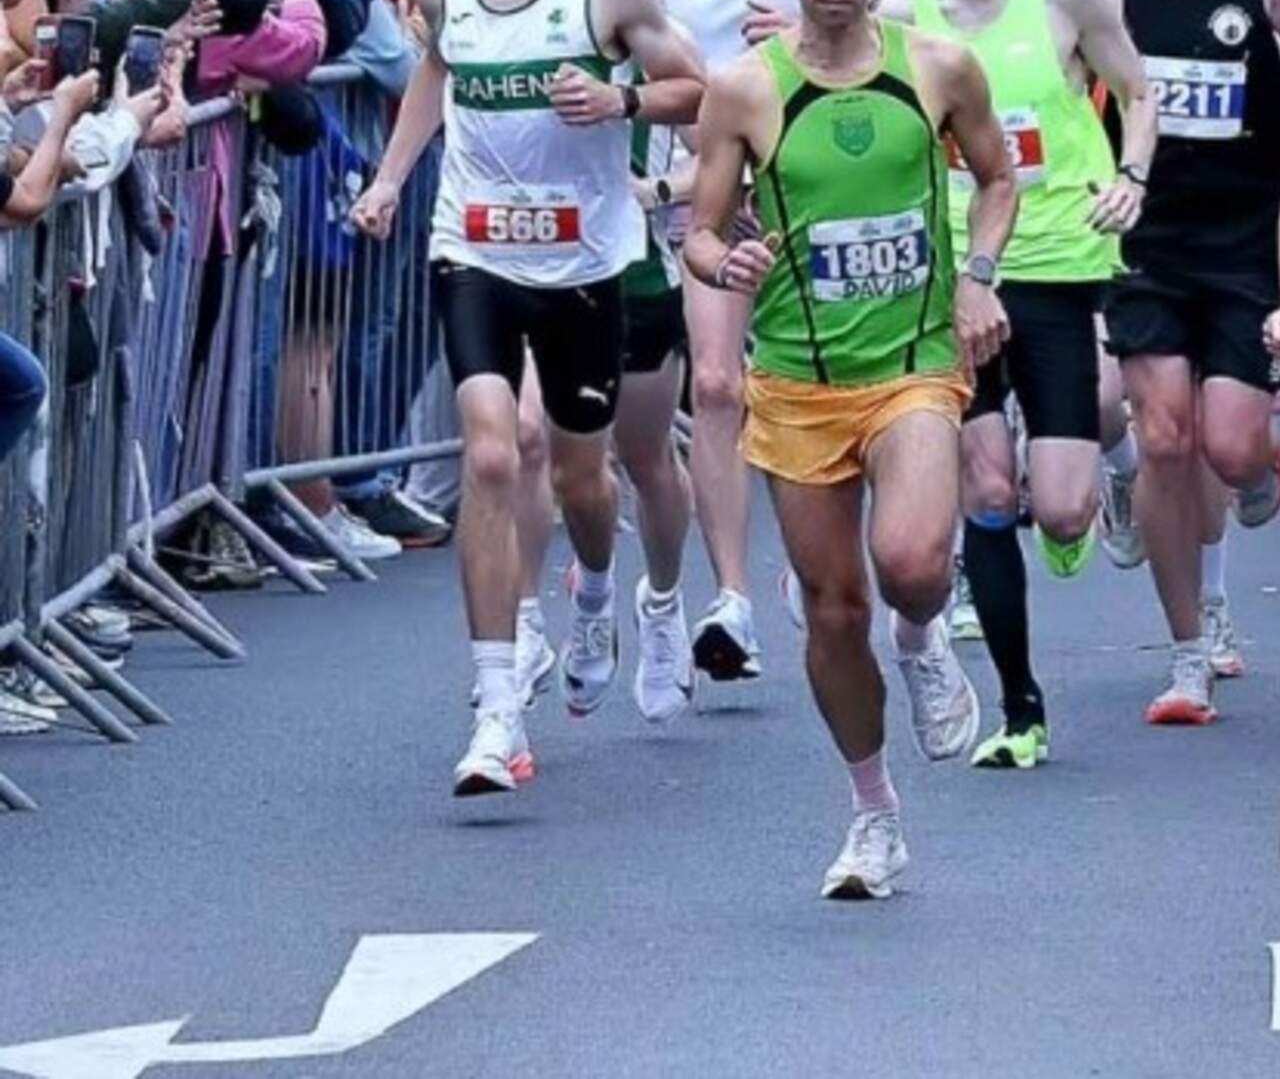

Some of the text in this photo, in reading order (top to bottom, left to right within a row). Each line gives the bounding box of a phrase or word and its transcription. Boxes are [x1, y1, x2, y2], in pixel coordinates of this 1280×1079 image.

[1150, 80, 1231, 117] 2211
[487, 207, 558, 241] 566
[821, 235, 919, 278] 1803
[843, 270, 917, 299] DAVID
